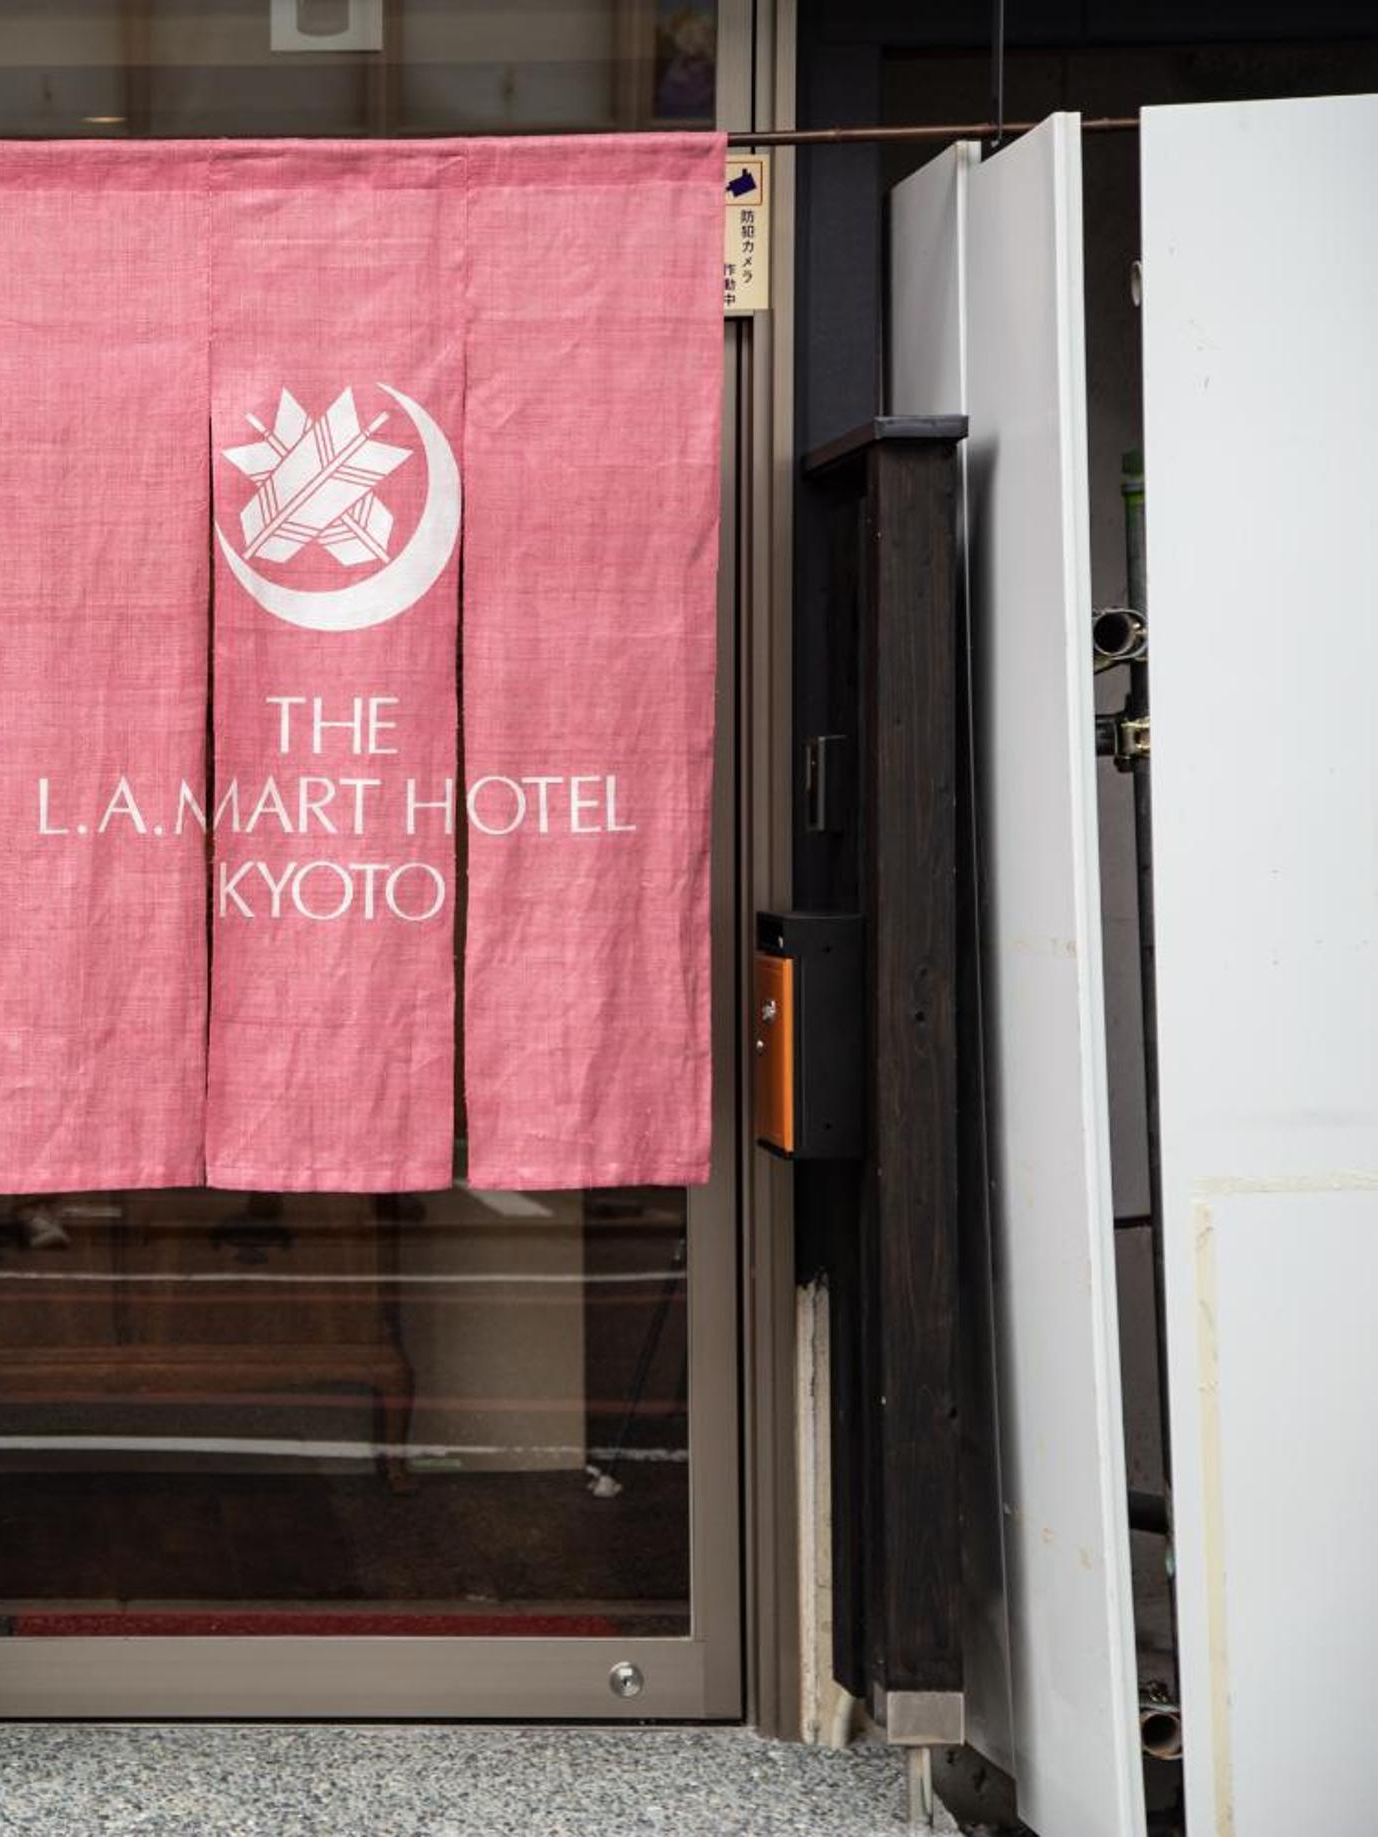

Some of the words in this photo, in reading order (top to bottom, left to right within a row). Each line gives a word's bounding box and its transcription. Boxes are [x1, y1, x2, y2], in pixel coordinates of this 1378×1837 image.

[740, 209, 755, 284] 防犯カメラ
[266, 696, 399, 755] THE
[38, 775, 382, 836] L.A.MART
[406, 775, 636, 836] HOTEL
[219, 860, 446, 922] KYOTO
